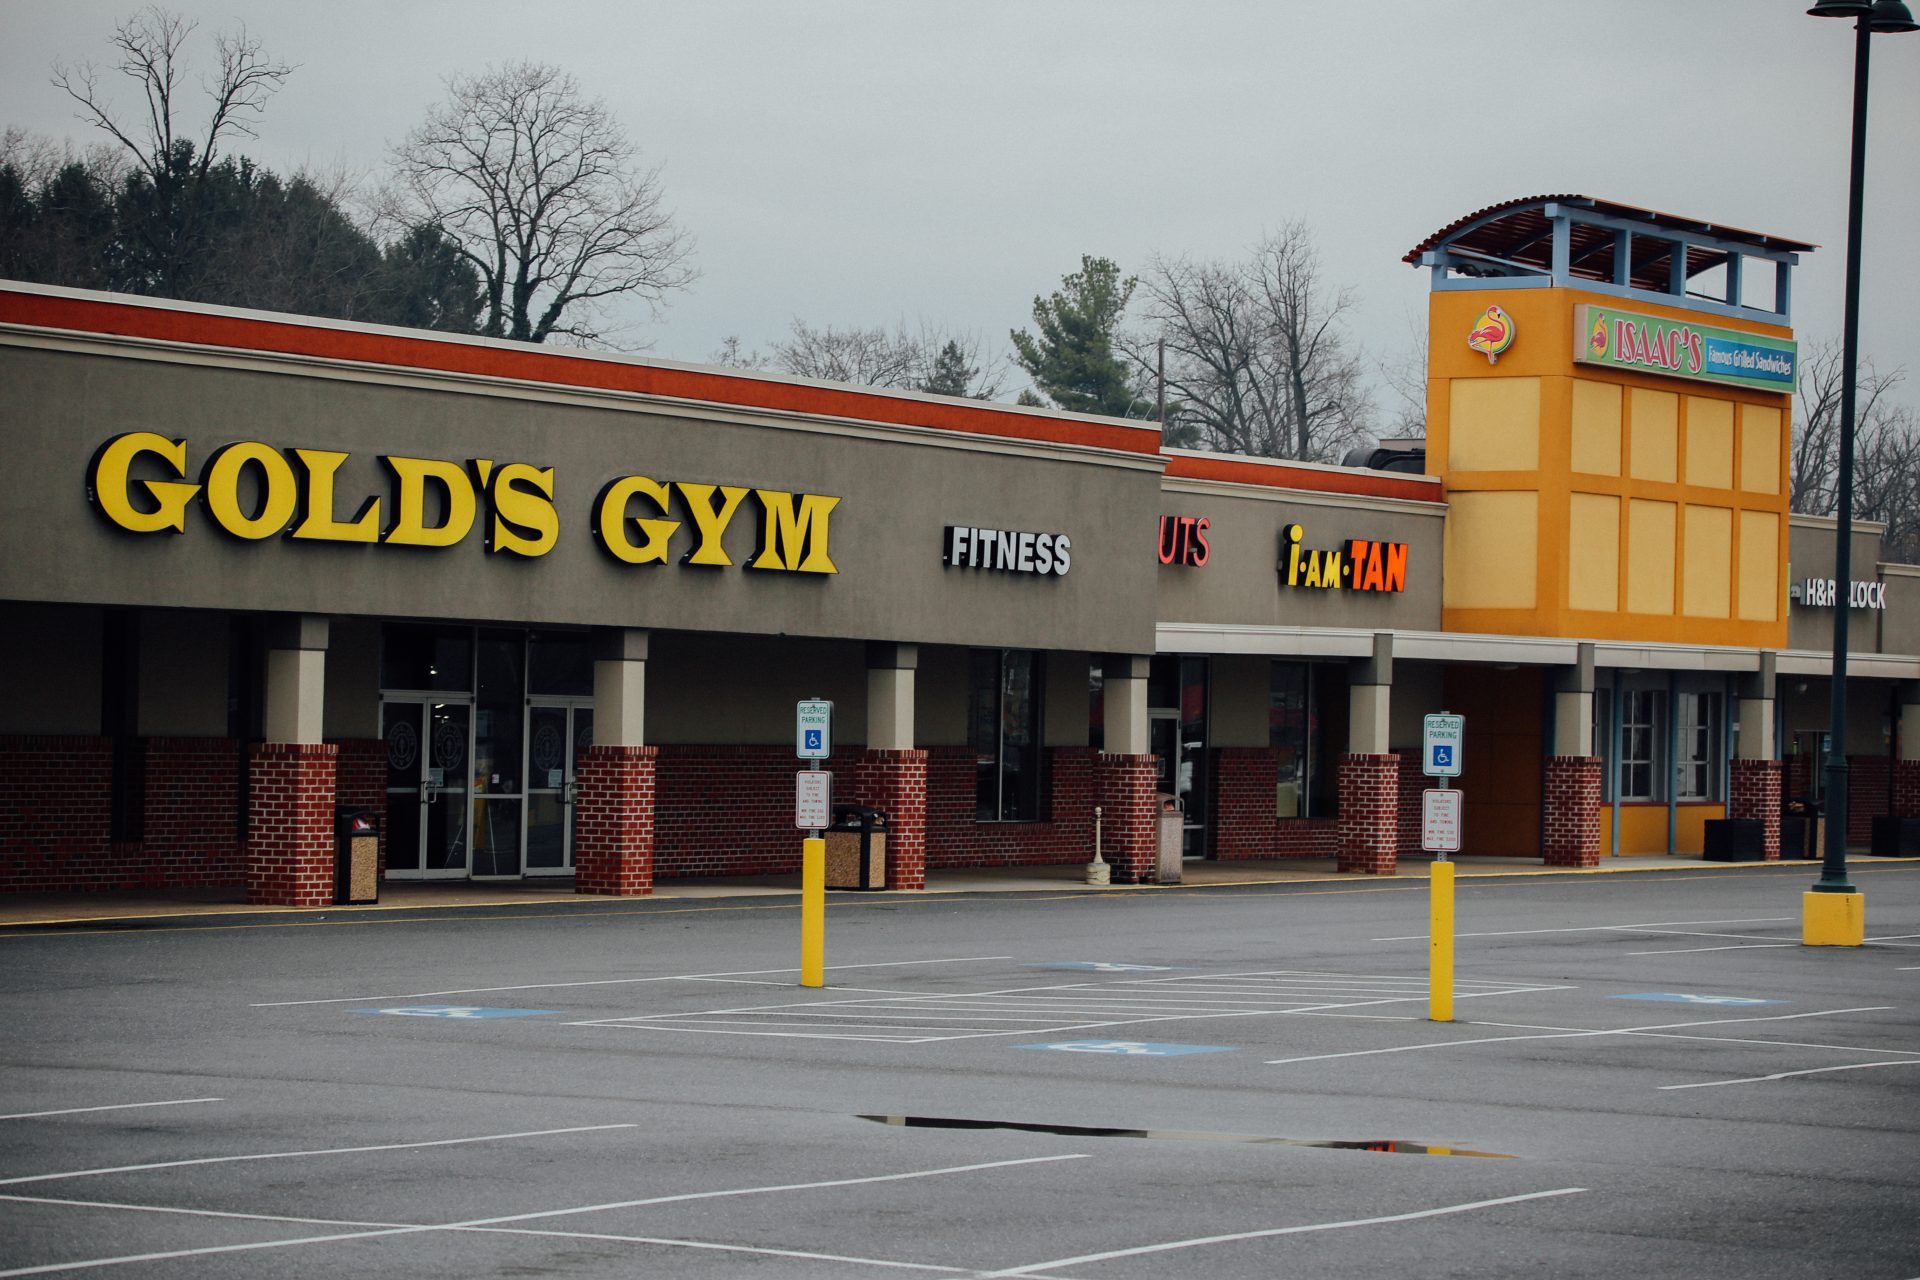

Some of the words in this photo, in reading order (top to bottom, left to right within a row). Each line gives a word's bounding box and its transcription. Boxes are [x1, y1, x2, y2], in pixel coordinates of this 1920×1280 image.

[1613, 318, 1702, 374] ISAAC'S
[1708, 345, 1733, 366] Famous
[1733, 349, 1755, 369] Grilled
[1755, 351, 1792, 376] Sandwiches
[93, 432, 560, 557] GOLD'S
[596, 475, 842, 574] GYM
[950, 526, 1072, 576] FITNESS
[1806, 578, 1836, 607] H&R
[1847, 580, 1887, 609] LOCK
[800, 706, 827, 715] RESERVED
[801, 716, 826, 724] PARKING
[1427, 720, 1459, 729] RESERVED
[1429, 730, 1457, 739] PARKING
